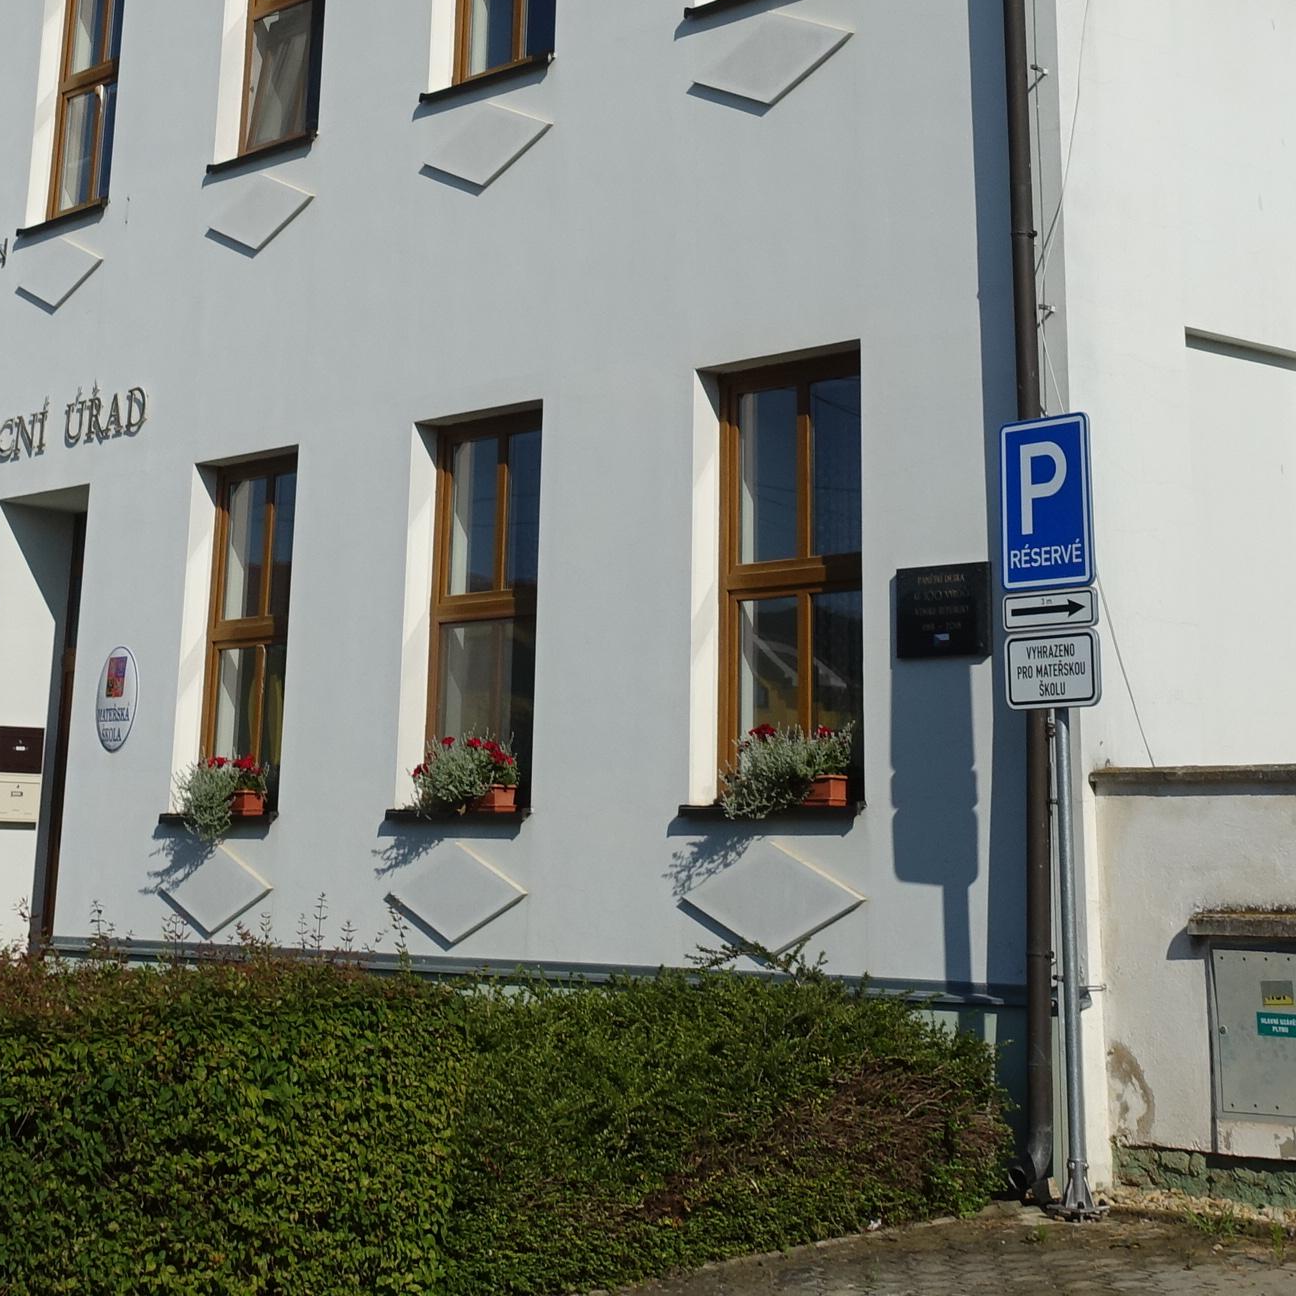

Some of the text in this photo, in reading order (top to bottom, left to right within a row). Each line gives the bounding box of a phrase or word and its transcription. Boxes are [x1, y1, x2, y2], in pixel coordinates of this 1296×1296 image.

[65, 378, 148, 445] ÚŘAD
[1019, 440, 1067, 535] P
[1010, 538, 1082, 569] RÉSERVÉ
[1026, 643, 1075, 660] VYHRAZENO
[1017, 660, 1086, 680] PRO MATEŘSKOU
[1039, 680, 1066, 697] ŠKOLU
